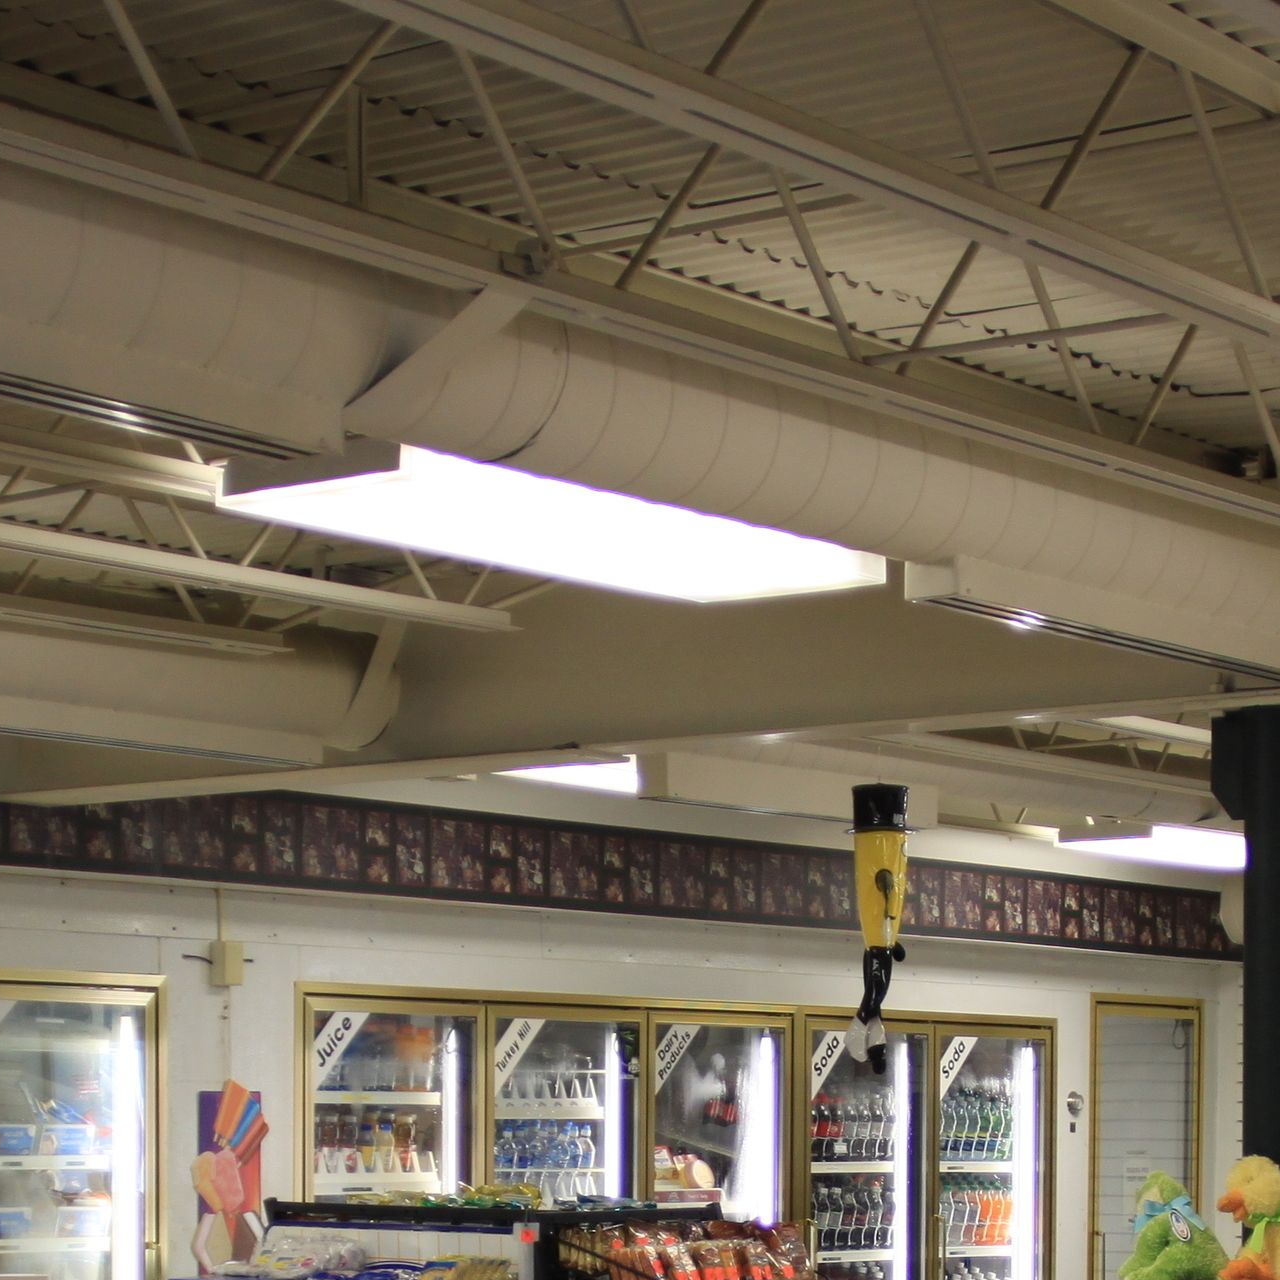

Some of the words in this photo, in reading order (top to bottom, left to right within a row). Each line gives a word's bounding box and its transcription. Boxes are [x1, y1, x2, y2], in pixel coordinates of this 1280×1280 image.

[318, 1016, 352, 1067] Juice
[496, 1040, 520, 1072] Turkey
[518, 1020, 532, 1042] Hill
[657, 1029, 679, 1062] Dairy
[658, 1031, 691, 1081] Products
[813, 1035, 840, 1076] Soda
[941, 1040, 966, 1080] Soda
